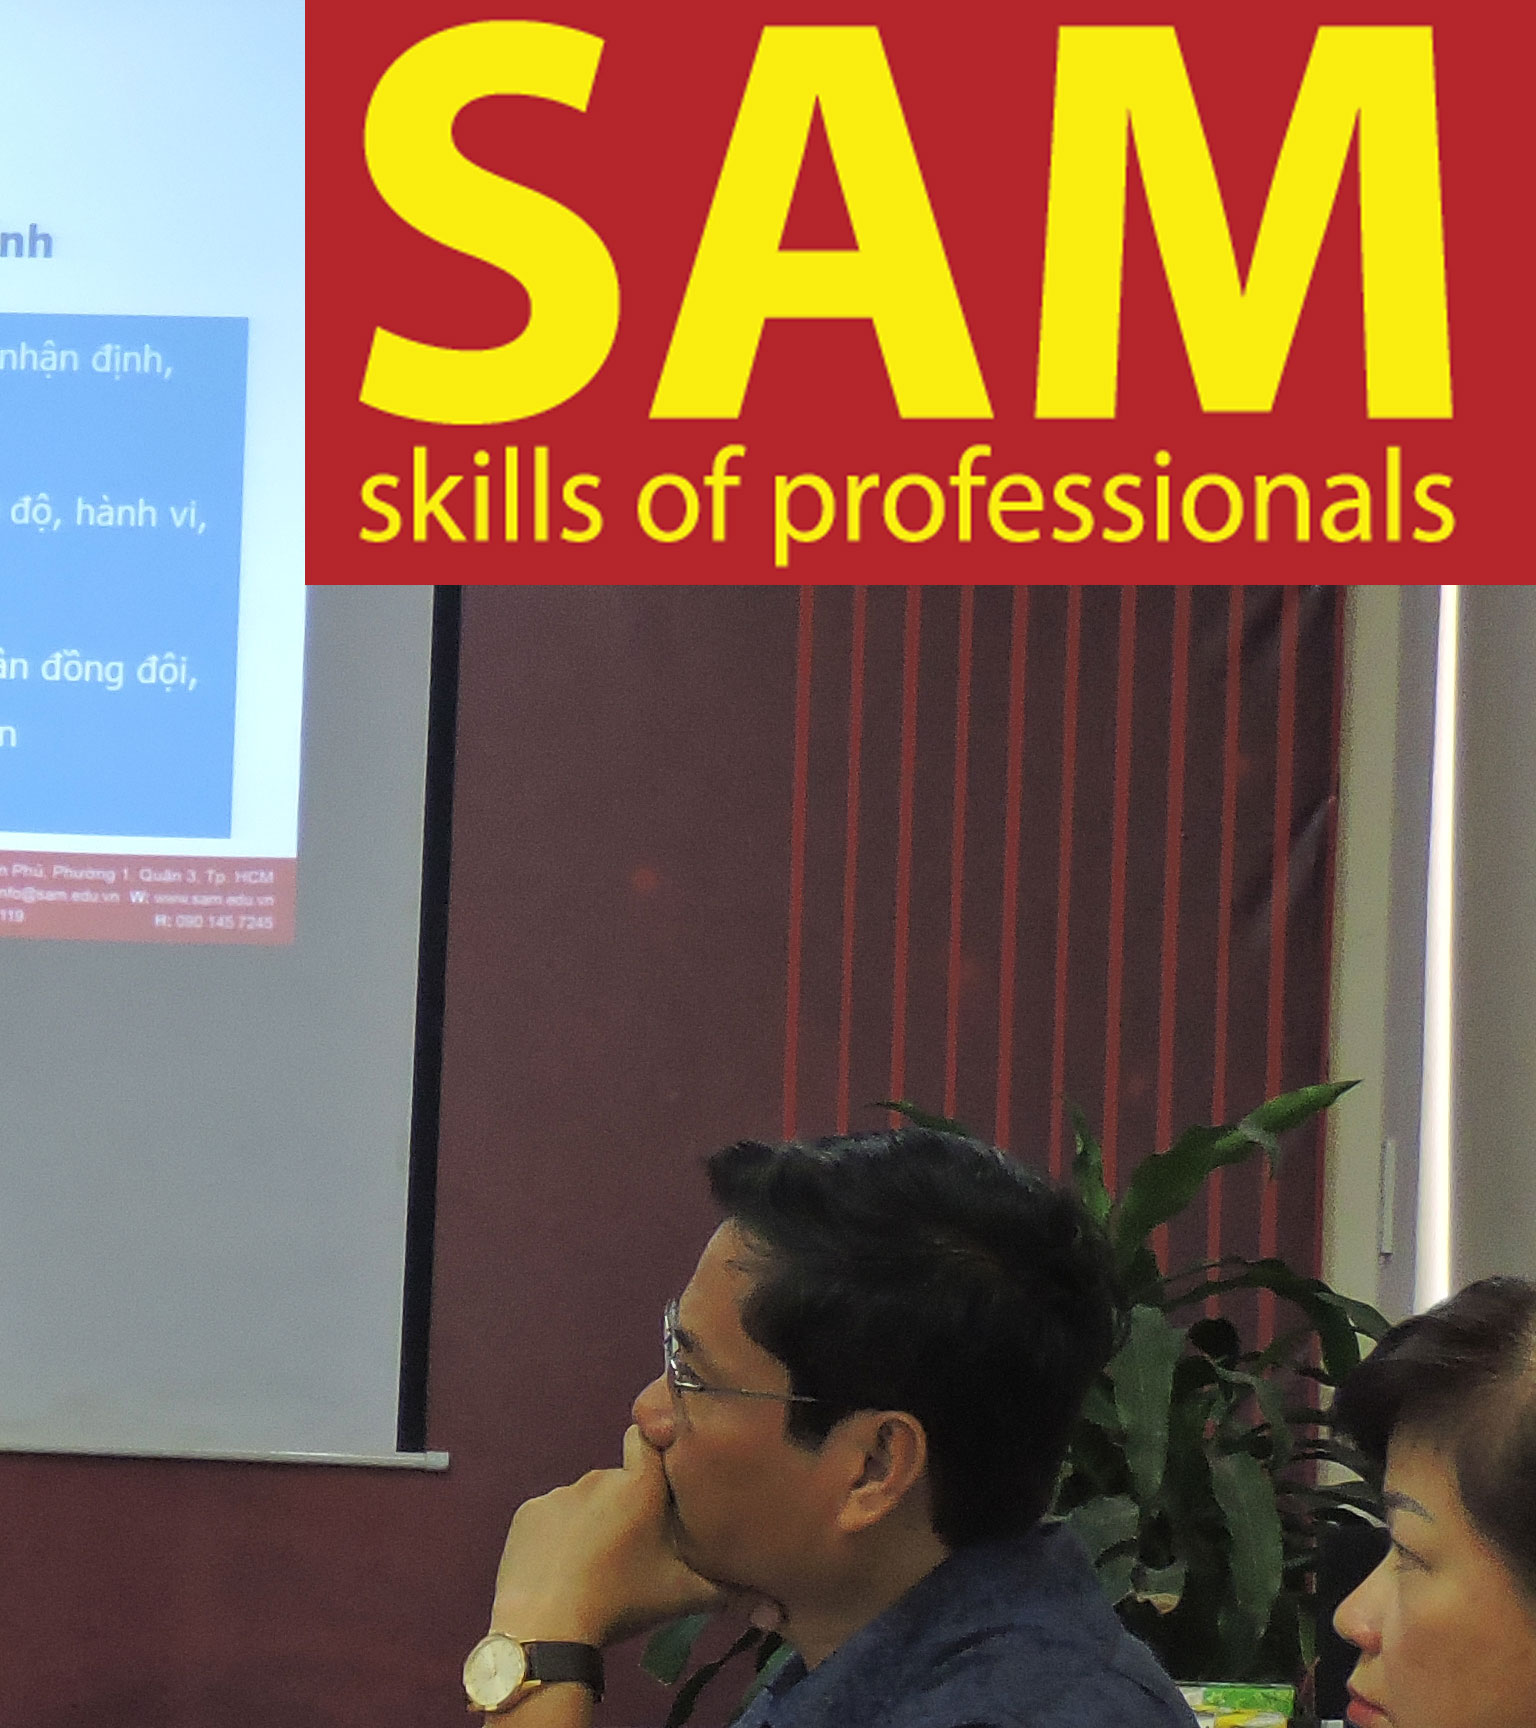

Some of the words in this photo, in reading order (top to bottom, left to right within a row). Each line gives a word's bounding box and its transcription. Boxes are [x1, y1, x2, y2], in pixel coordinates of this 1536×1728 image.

[91, 342, 175, 380] định,
[10, 495, 62, 533] độ,
[75, 496, 158, 528] hành
[169, 499, 207, 535] vi,
[41, 651, 124, 691] đồng
[136, 655, 199, 692] đội,
